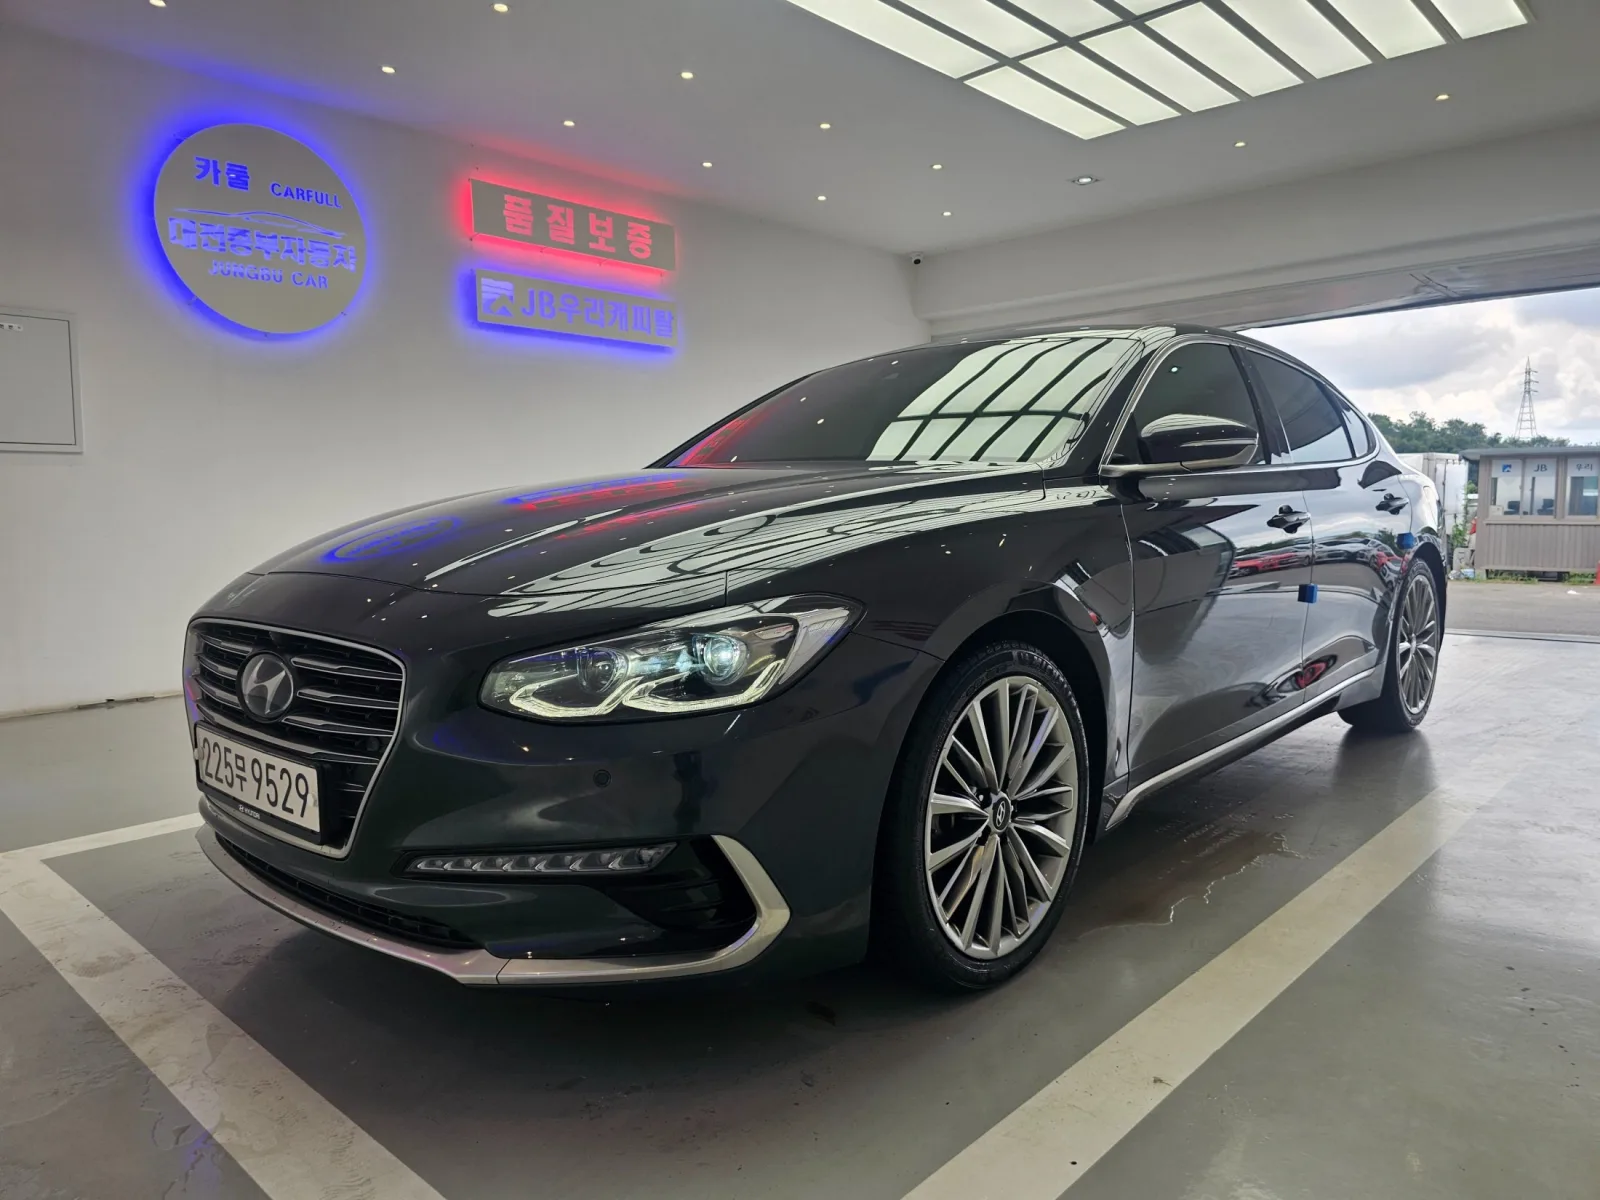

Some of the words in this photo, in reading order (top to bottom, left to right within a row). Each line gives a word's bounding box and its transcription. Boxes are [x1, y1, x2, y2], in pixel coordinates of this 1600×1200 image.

[270, 182, 342, 209] CARFULL
[503, 194, 653, 260] 품질보증
[209, 259, 283, 284] JUNGBU
[291, 271, 329, 289] CAR
[1533, 463, 1548, 472] JB
